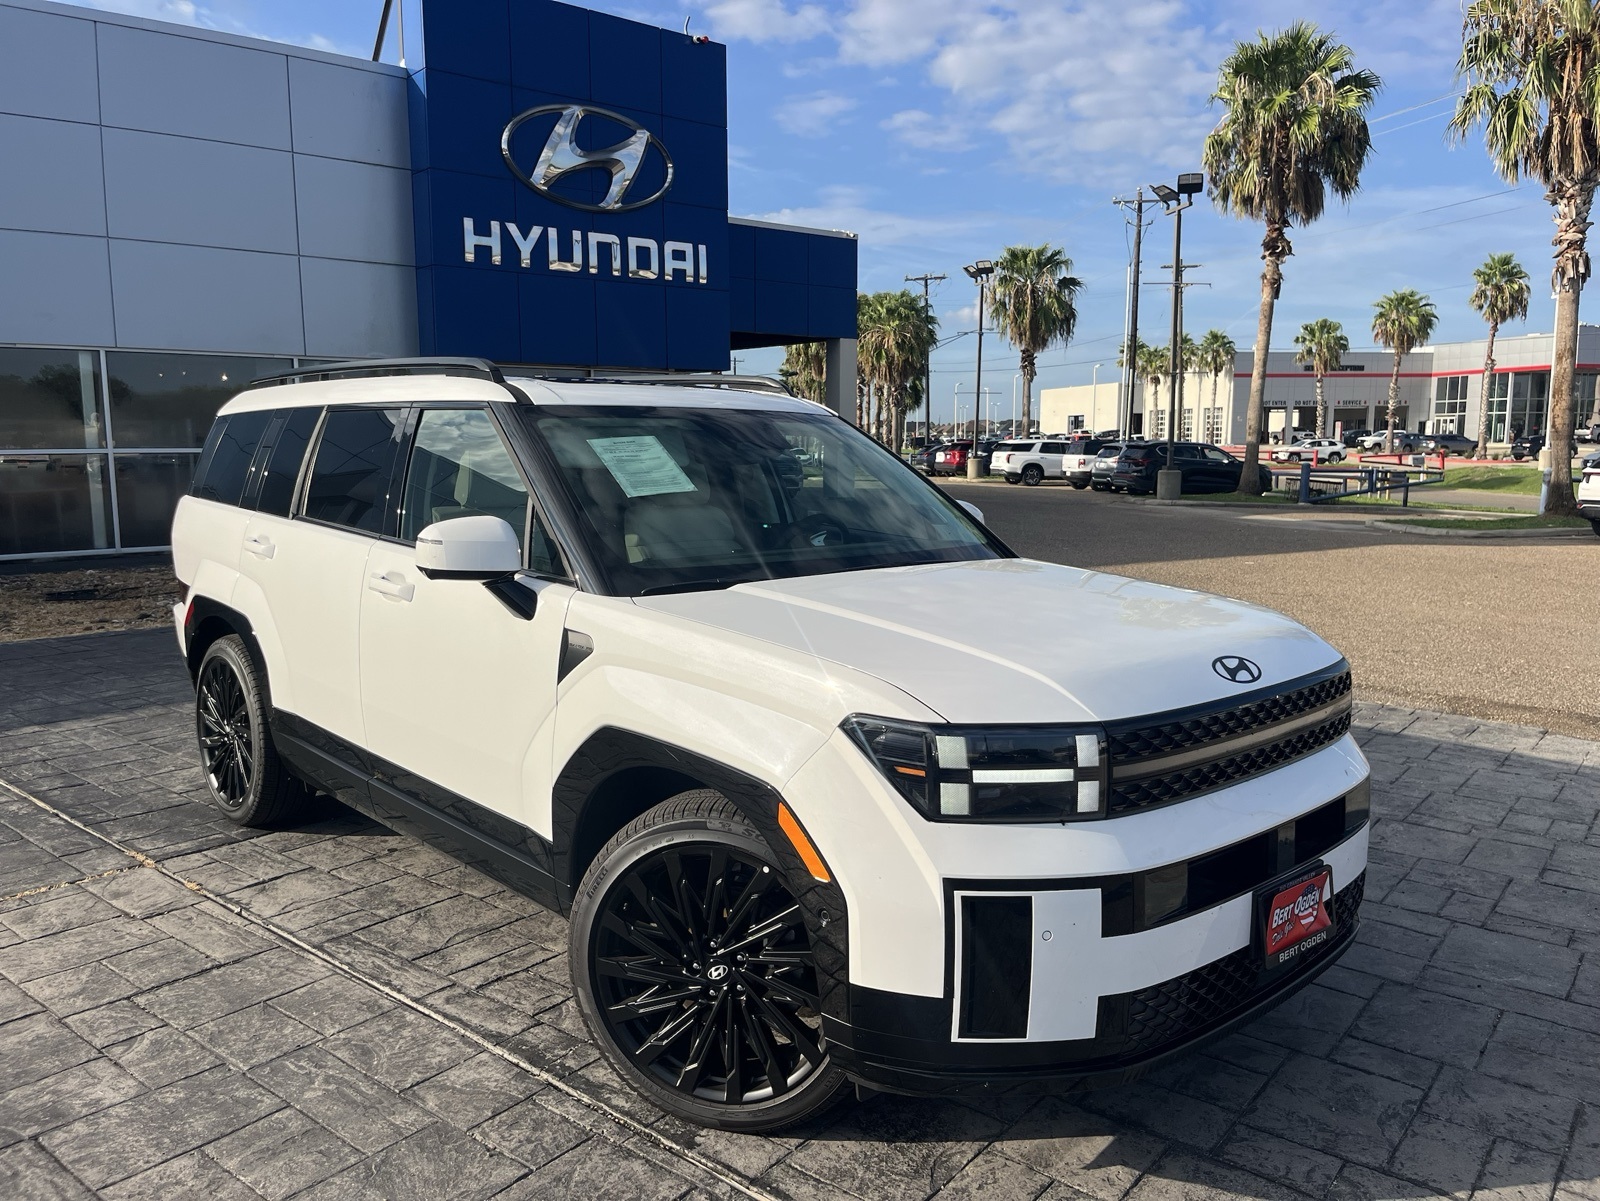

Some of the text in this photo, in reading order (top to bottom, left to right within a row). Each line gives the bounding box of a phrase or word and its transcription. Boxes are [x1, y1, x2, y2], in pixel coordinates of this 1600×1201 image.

[463, 216, 708, 284] HYUNDAI
[1272, 888, 1320, 929] BERT OGDEN
[1279, 931, 1328, 963] BERT OGDEN
